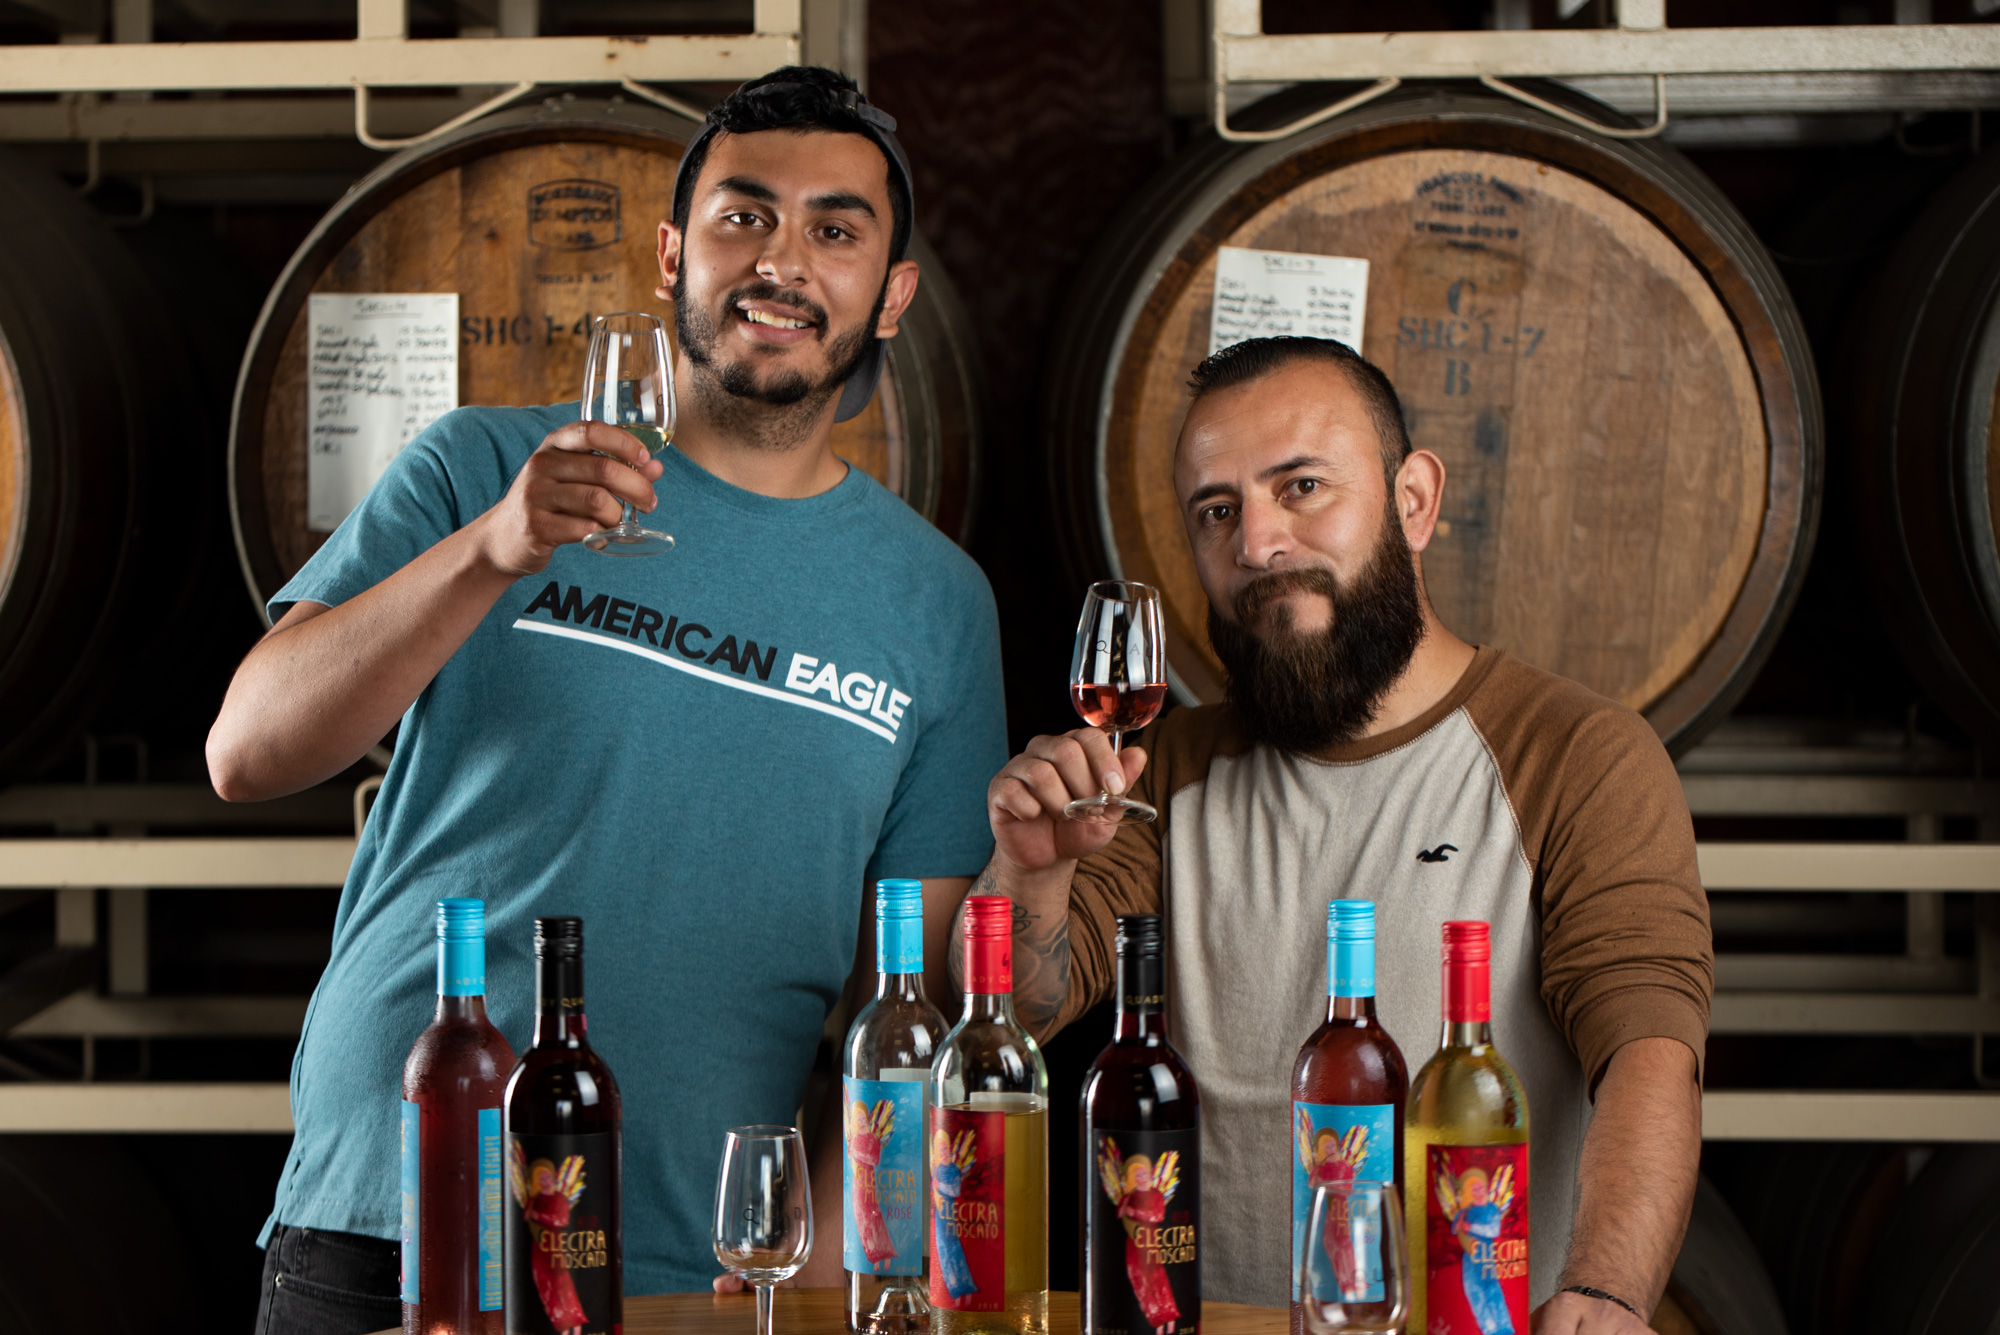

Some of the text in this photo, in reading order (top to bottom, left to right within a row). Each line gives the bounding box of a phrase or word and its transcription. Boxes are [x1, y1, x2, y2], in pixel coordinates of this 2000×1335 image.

[461, 313, 533, 346] SHC
[1396, 316, 1471, 350] SHC
[1444, 357, 1471, 396] B
[523, 580, 913, 732] AMERICAN EAGLE
[857, 1167, 917, 1189] ELECTRA
[864, 1188, 917, 1205] MOSCATO
[886, 1205, 913, 1220] ROSÉ
[939, 1198, 999, 1223] ELECTRA
[540, 1229, 608, 1252] ELECTRA
[945, 1222, 999, 1239] MOSCATO
[1134, 1224, 1195, 1248] ELECTRA
[551, 1251, 608, 1269] MOSCATO
[1146, 1245, 1196, 1264] MOSCATO
[1470, 1239, 1527, 1264] ELECTRA
